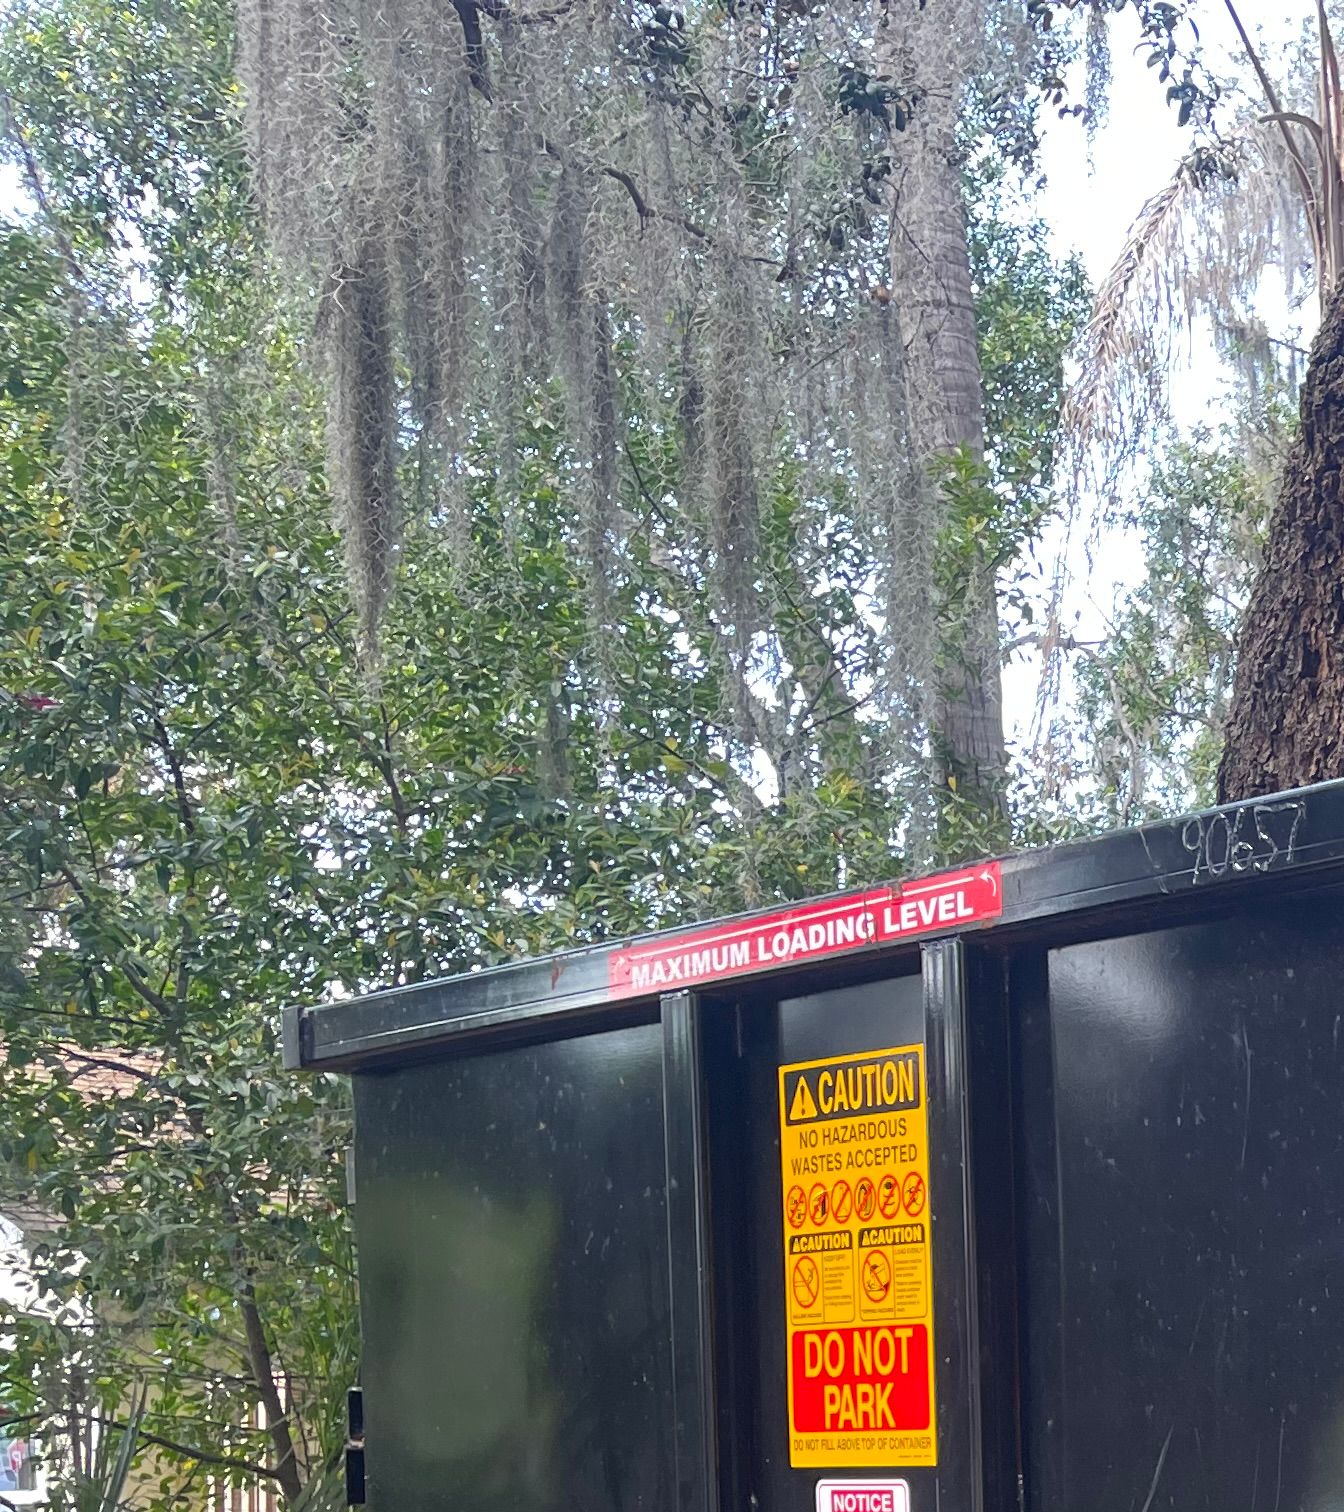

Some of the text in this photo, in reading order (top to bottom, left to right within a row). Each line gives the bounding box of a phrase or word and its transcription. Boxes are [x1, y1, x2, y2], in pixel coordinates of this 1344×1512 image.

[631, 890, 973, 989] MAXIMUM LOADING LEVEL
[818, 1059, 913, 1113] CAUTION
[800, 1118, 907, 1149] NO HAZARDOUS
[792, 1144, 917, 1176] WASTES ACCEPTED
[800, 1233, 849, 1251] CAUTION
[870, 1225, 922, 1244] CAUTION
[804, 1328, 913, 1378] DO NOT
[824, 1382, 896, 1429] PARK
[794, 1437, 931, 1451] DO NOT FILL ABOVE TOP OF CONTAINER
[834, 1494, 891, 1512] NOTICE
